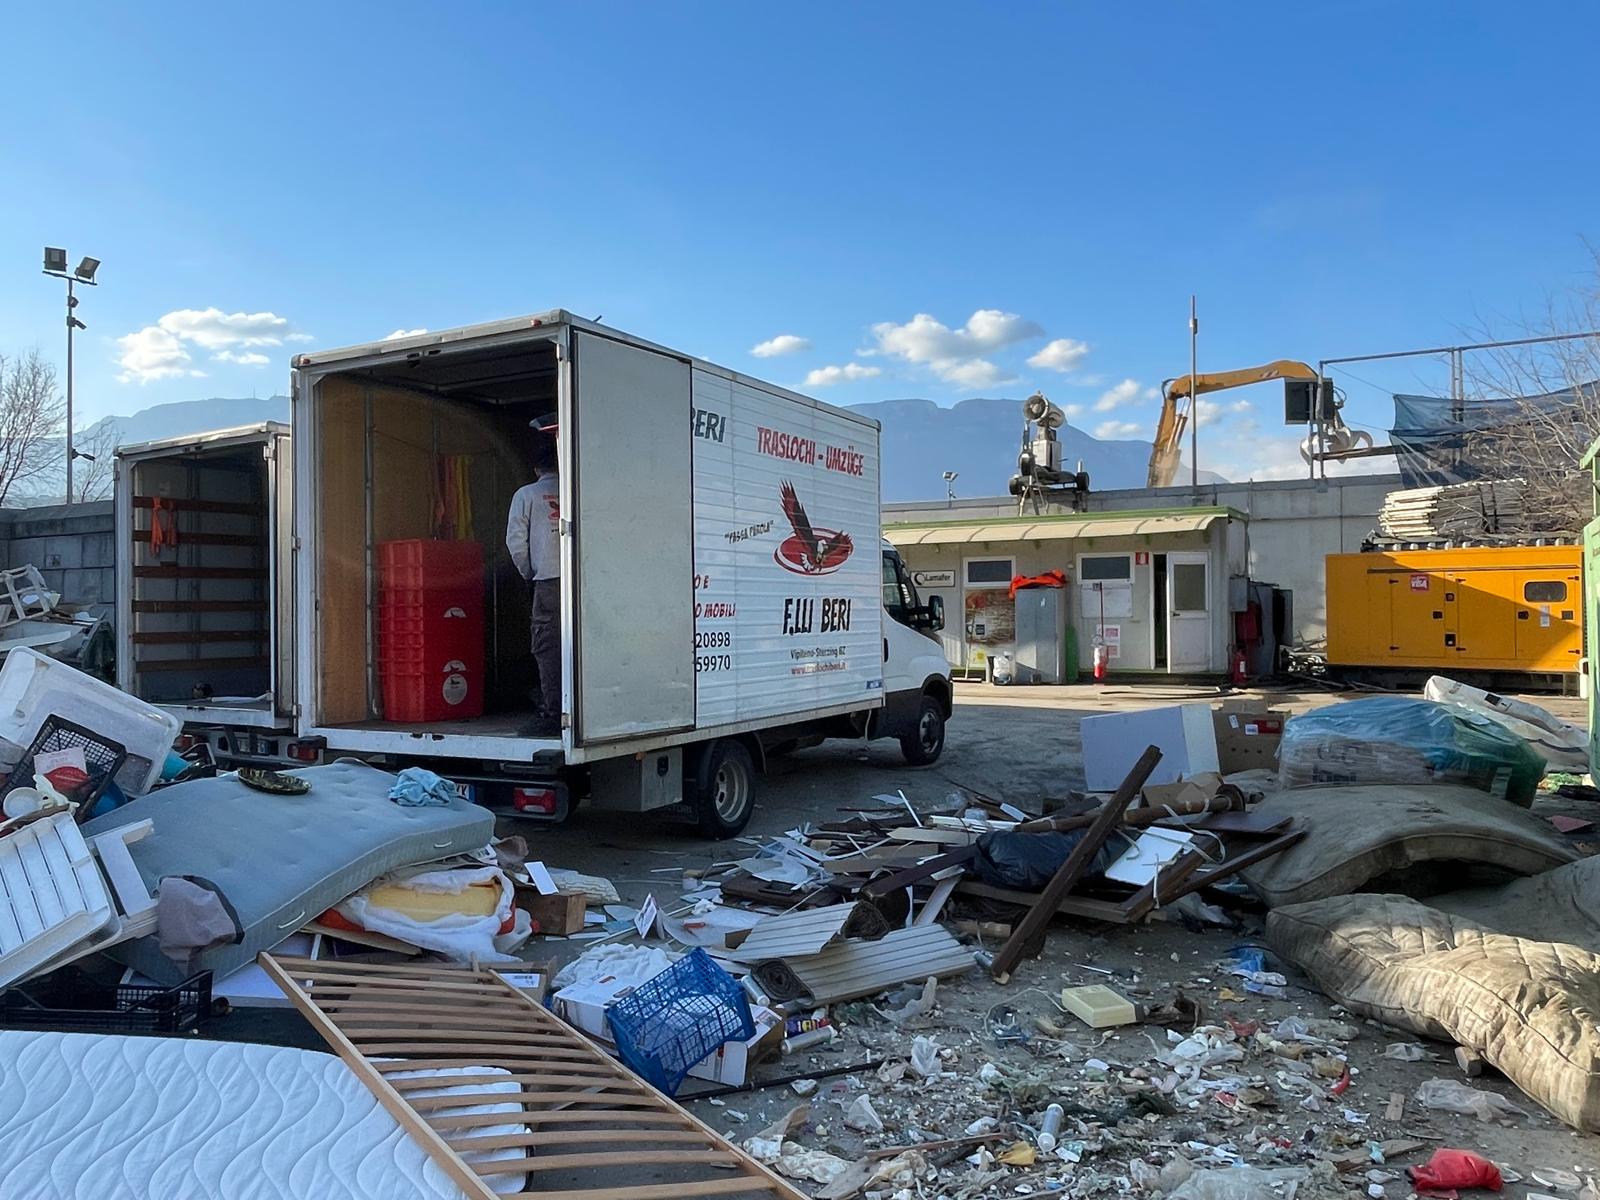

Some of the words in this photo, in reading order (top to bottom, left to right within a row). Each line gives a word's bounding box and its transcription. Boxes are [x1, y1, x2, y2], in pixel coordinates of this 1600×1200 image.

[757, 426, 816, 466] TRASLOCHI
[825, 445, 864, 477] UMZÜGE
[703, 575, 710, 589] E
[704, 603, 736, 618] MOBILI
[783, 598, 814, 636] F.LLI
[821, 598, 851, 633] BERI
